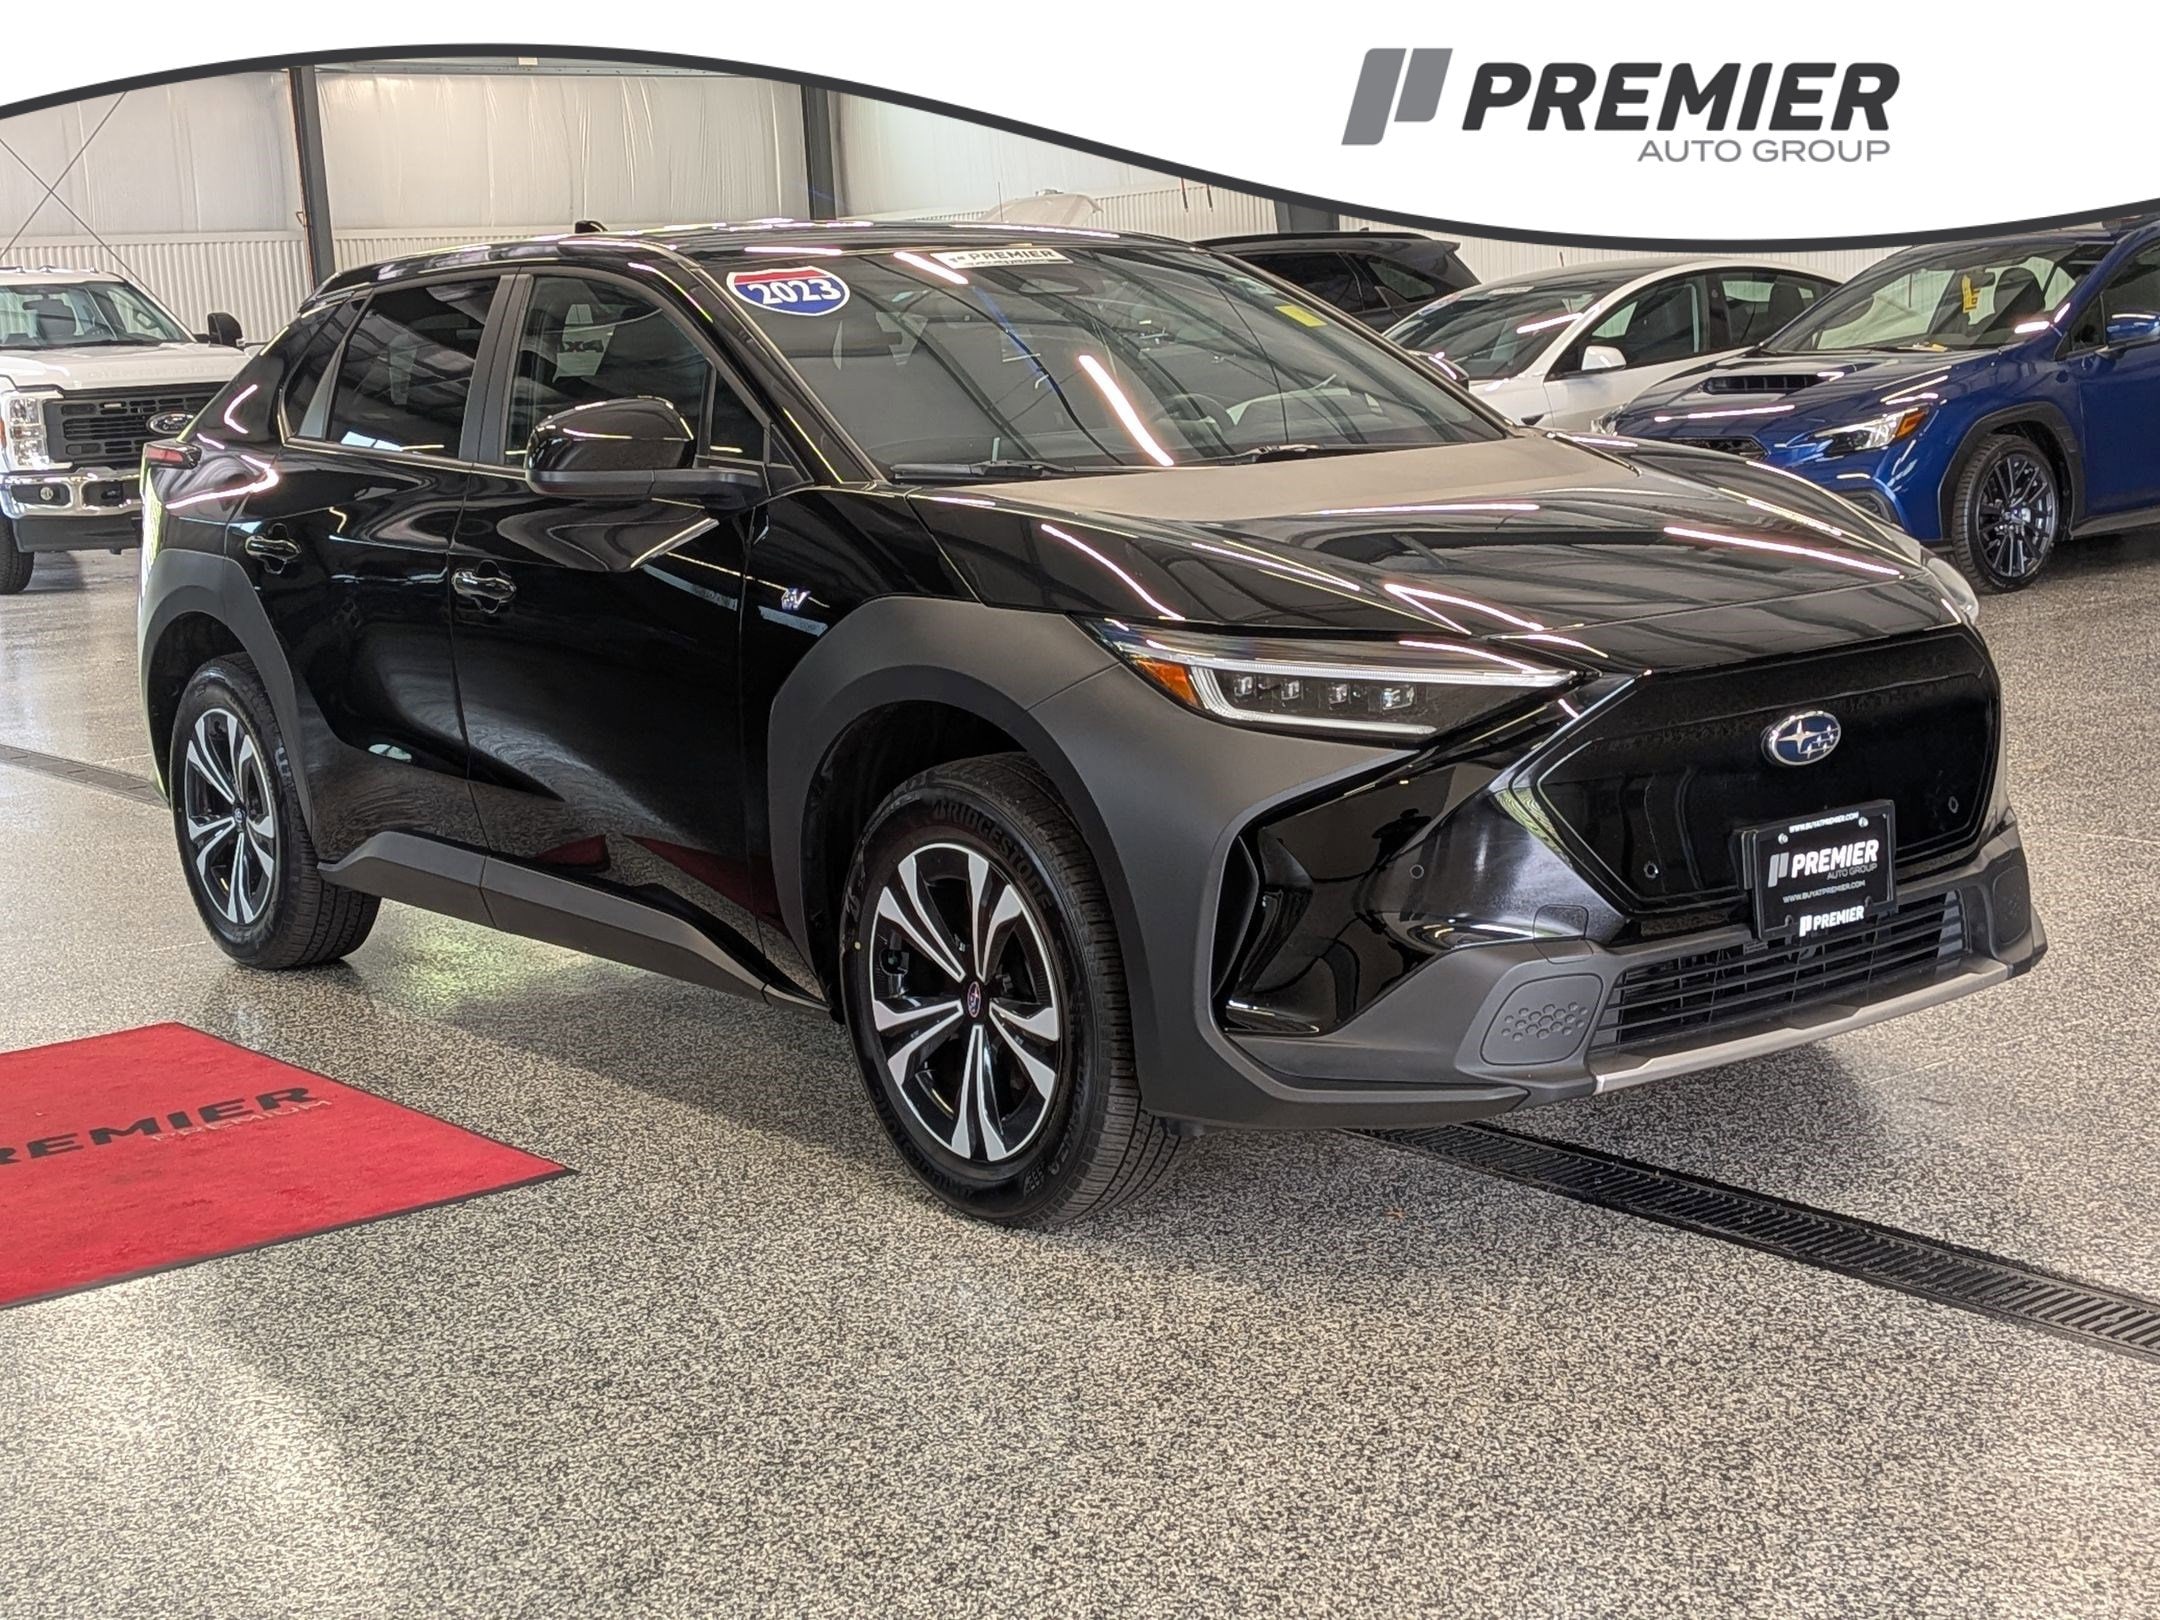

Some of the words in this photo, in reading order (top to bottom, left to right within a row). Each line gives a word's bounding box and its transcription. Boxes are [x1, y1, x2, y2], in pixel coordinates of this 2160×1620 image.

[968, 249, 1057, 260] PREMIER
[747, 278, 842, 305] 2023
[1791, 839, 1879, 878] PREMIER
[1826, 868, 1849, 880] AUTO
[1849, 863, 1878, 876] GROUP
[1813, 905, 1864, 930] PREMIER
